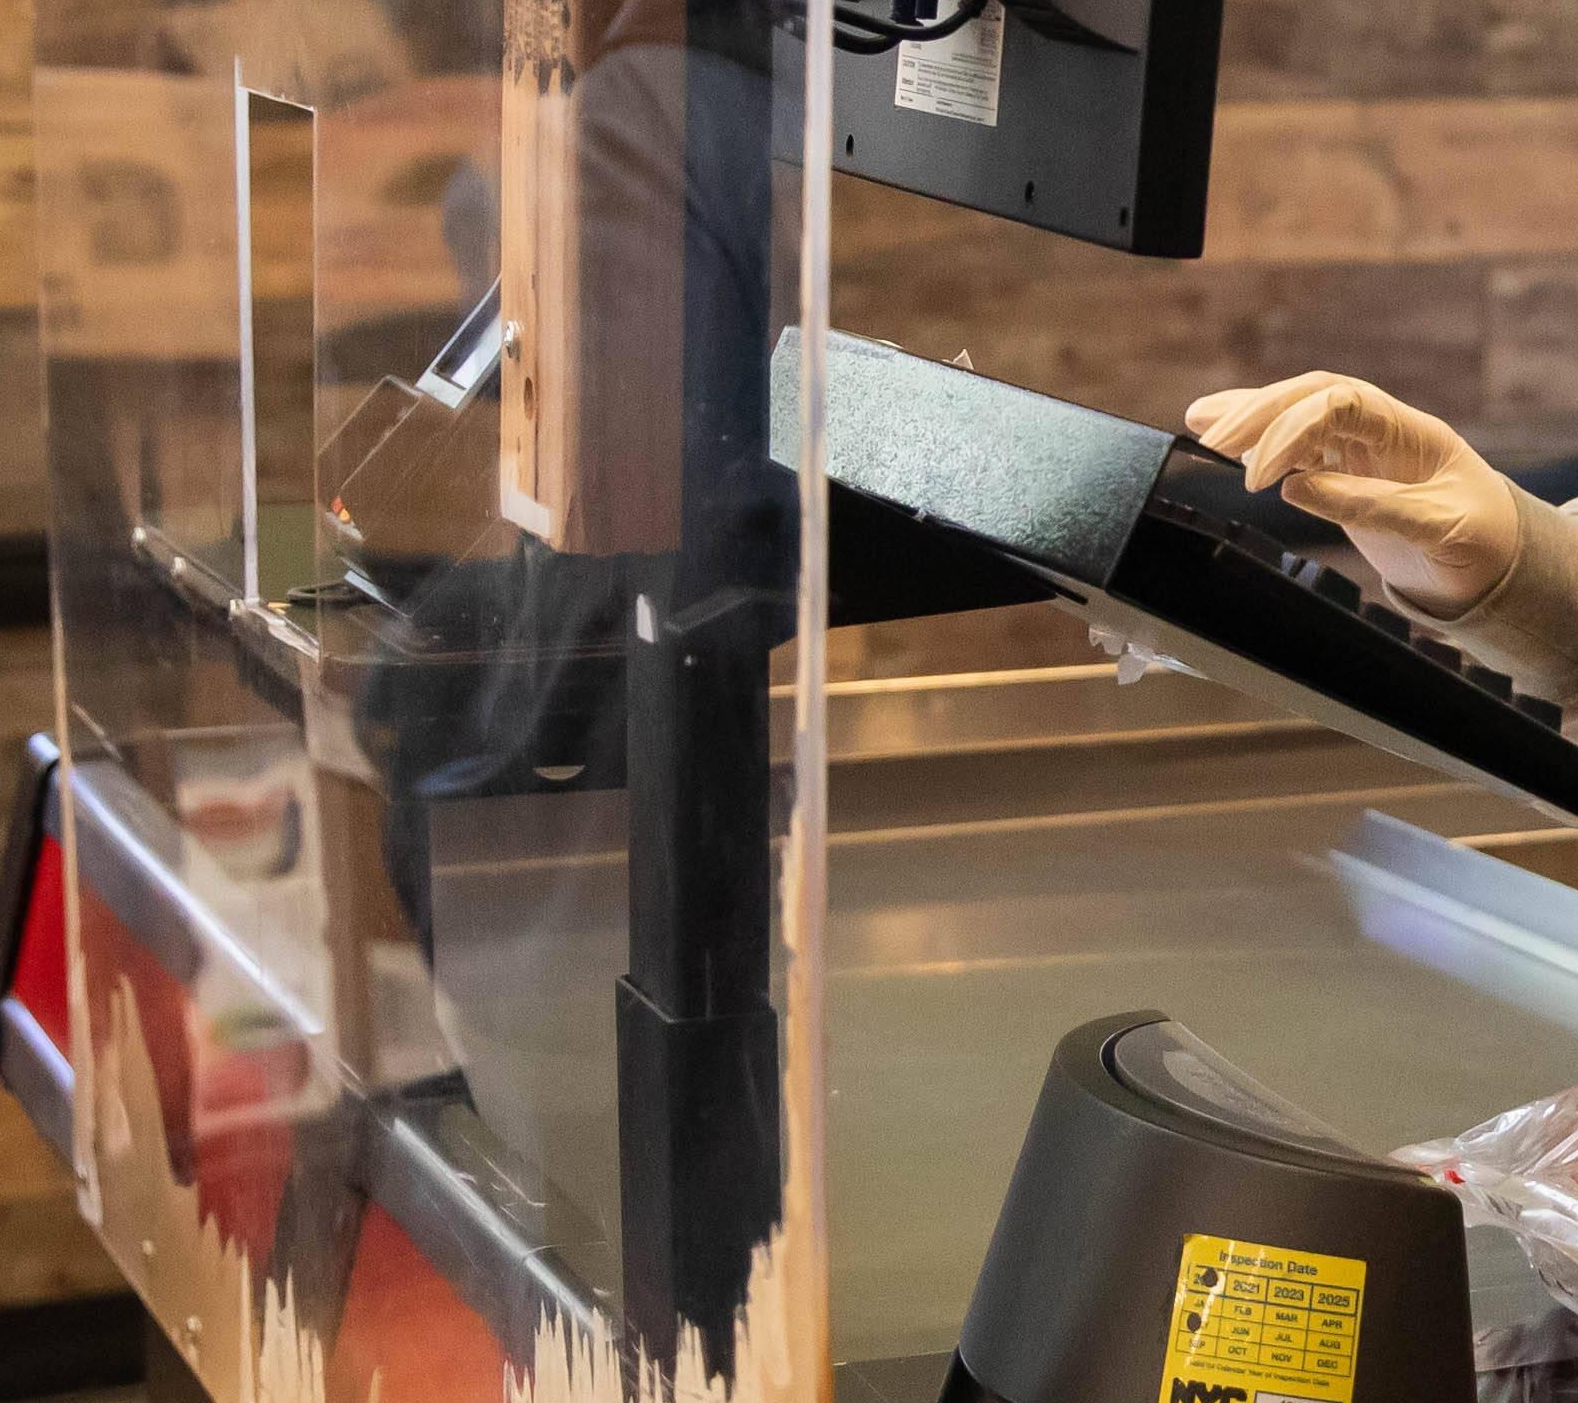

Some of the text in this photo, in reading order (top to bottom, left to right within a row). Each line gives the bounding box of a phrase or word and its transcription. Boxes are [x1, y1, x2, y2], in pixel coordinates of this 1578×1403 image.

[1287, 1261, 1318, 1275] Date
[1318, 1293, 1350, 1307] 2025
[1276, 1312, 1297, 1323] MAR
[1322, 1319, 1342, 1329] APR
[1231, 1326, 1340, 1350] JUN JUL AUG
[1228, 1345, 1247, 1356] OCT
[1271, 1351, 1292, 1363] NOV
[1317, 1358, 1338, 1369] DEC
